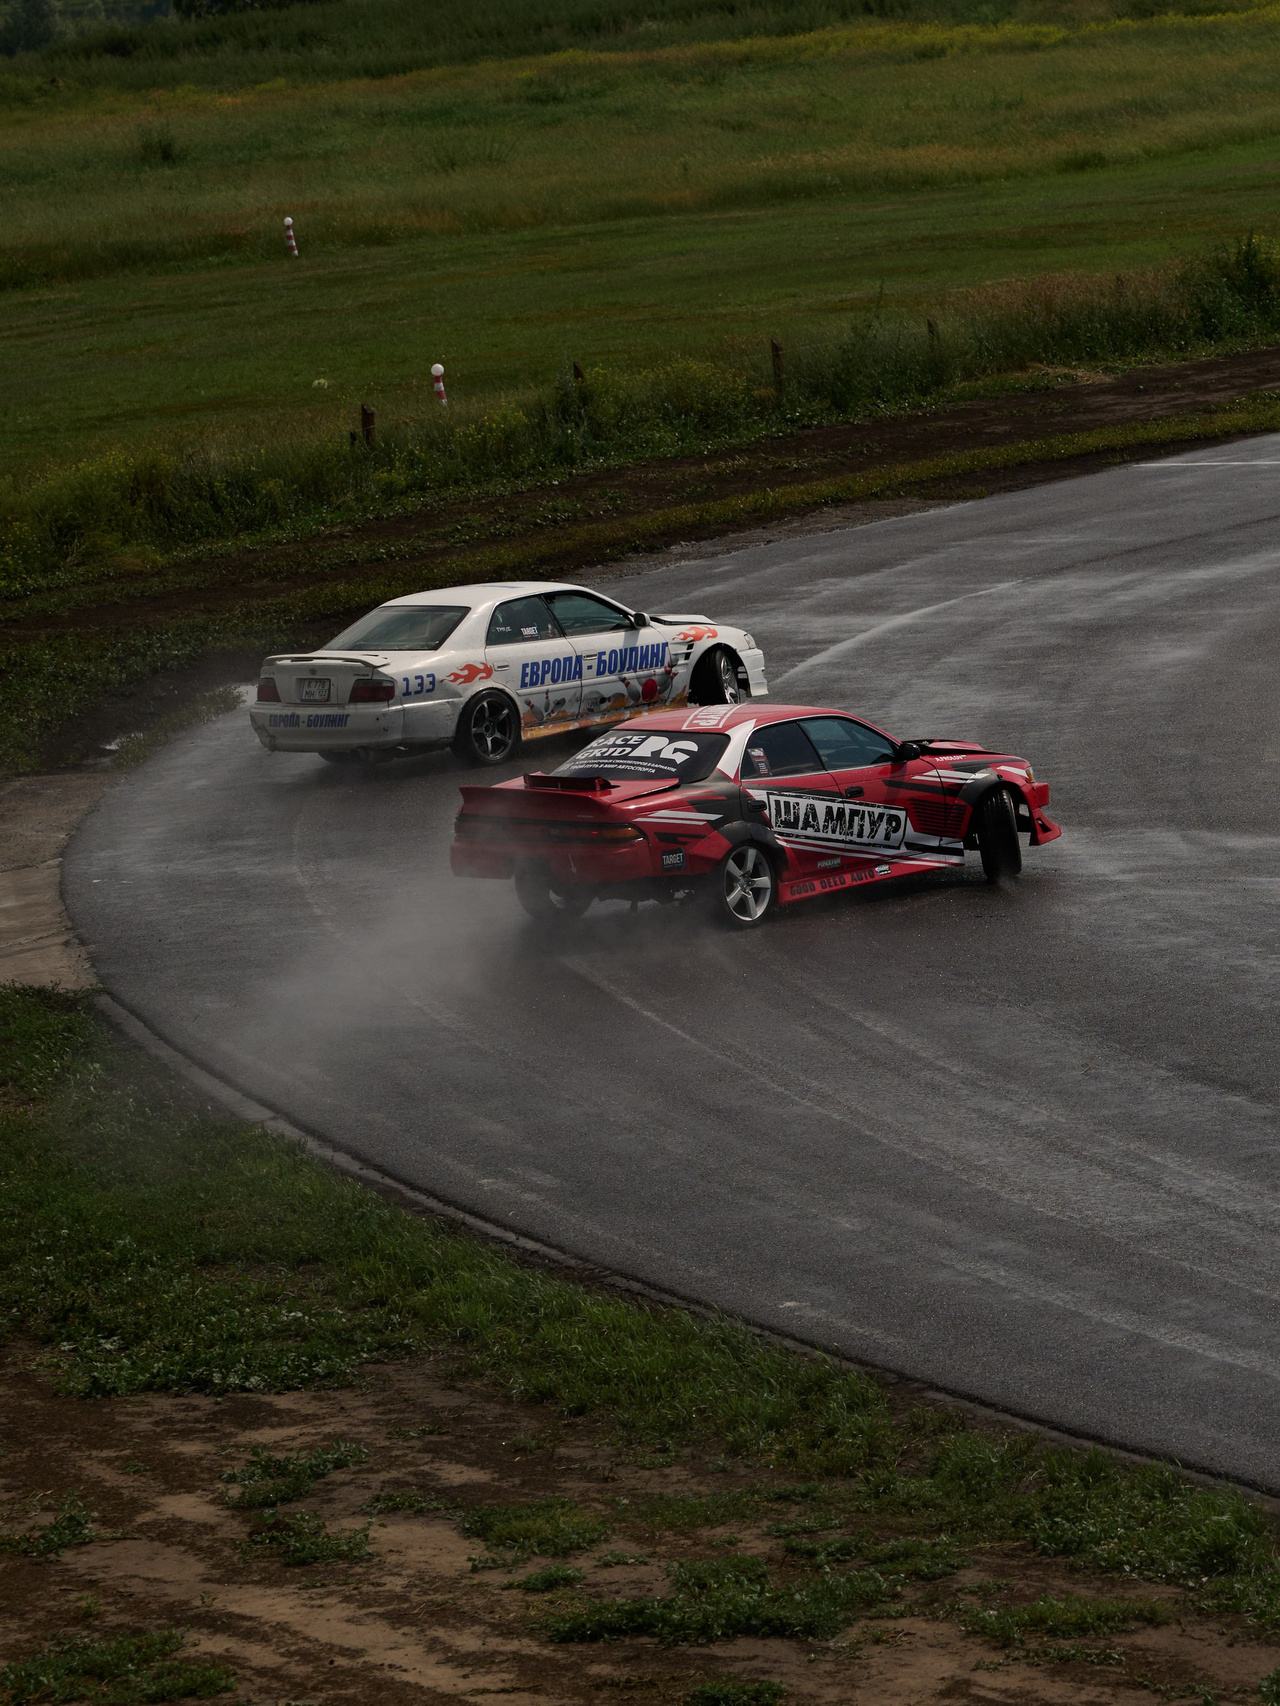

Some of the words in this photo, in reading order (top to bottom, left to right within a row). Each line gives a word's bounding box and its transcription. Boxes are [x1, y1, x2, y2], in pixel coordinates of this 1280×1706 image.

[520, 654, 583, 689] ЕВРОПА
[596, 641, 669, 676] БОУЛИНГ
[402, 673, 436, 697] 133
[269, 714, 301, 728] ЕВРОПА
[306, 713, 350, 728] БОУЛИНГ
[587, 735, 647, 749] RACE
[575, 747, 633, 759] GRID
[616, 764, 656, 774] АВТОСПОРТА
[773, 799, 902, 842] ШАМПУР
[662, 853, 684, 865] TARGET
[790, 881, 816, 896] GOOD
[819, 875, 846, 890] DEED
[850, 868, 875, 883] AUTO
